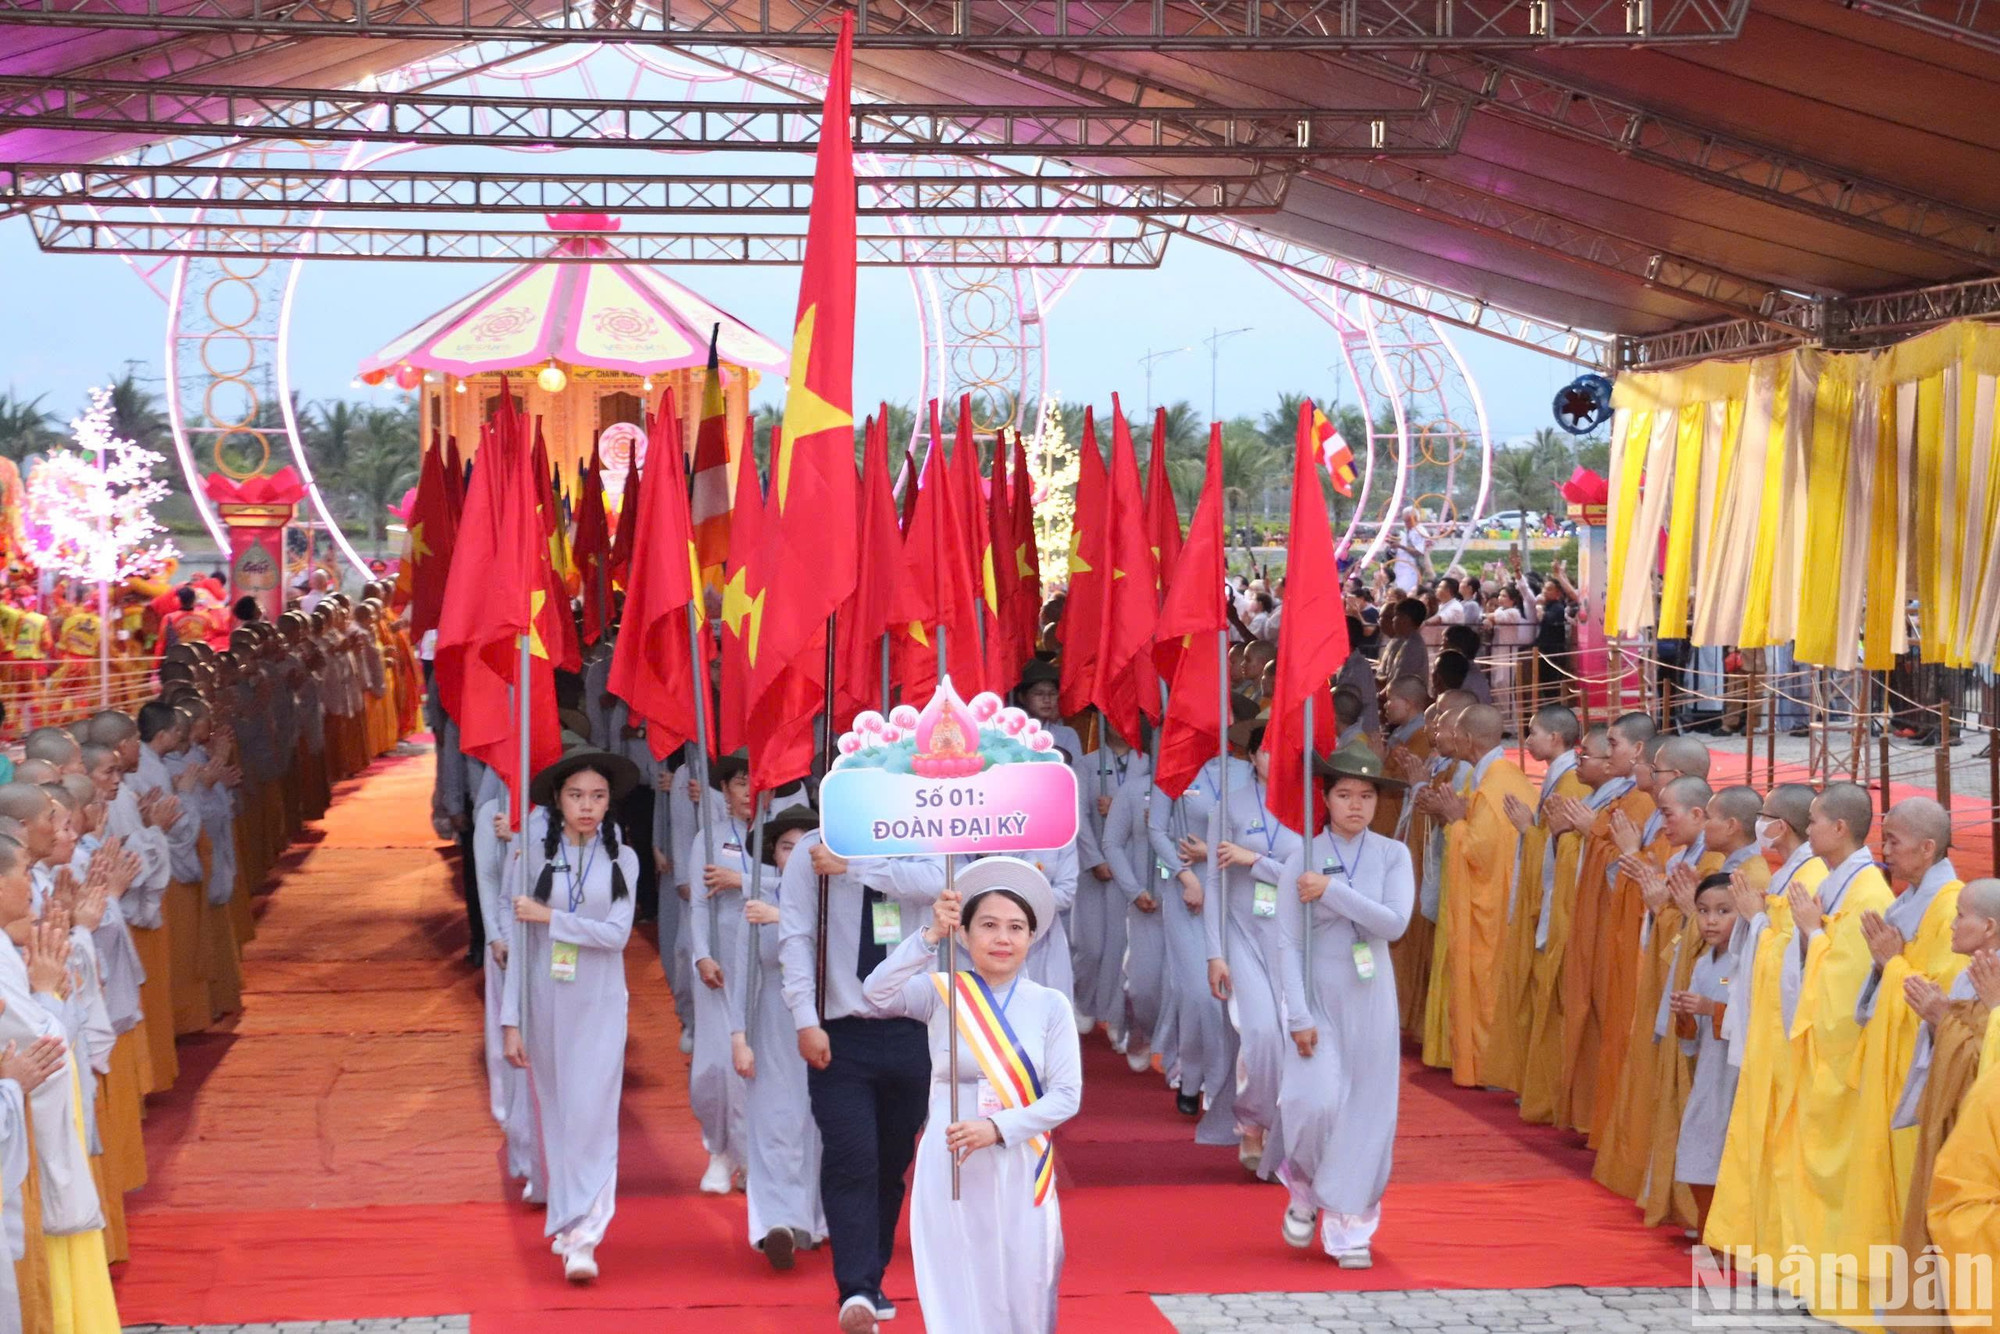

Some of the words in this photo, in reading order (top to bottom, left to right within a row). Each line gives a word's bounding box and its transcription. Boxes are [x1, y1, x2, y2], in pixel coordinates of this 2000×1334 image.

[915, 786, 944, 808] Số
[949, 788, 984, 807] 01:
[873, 815, 943, 840] ĐOÀN
[949, 817, 990, 841] ĐẠI
[997, 812, 1027, 835] KỲ
